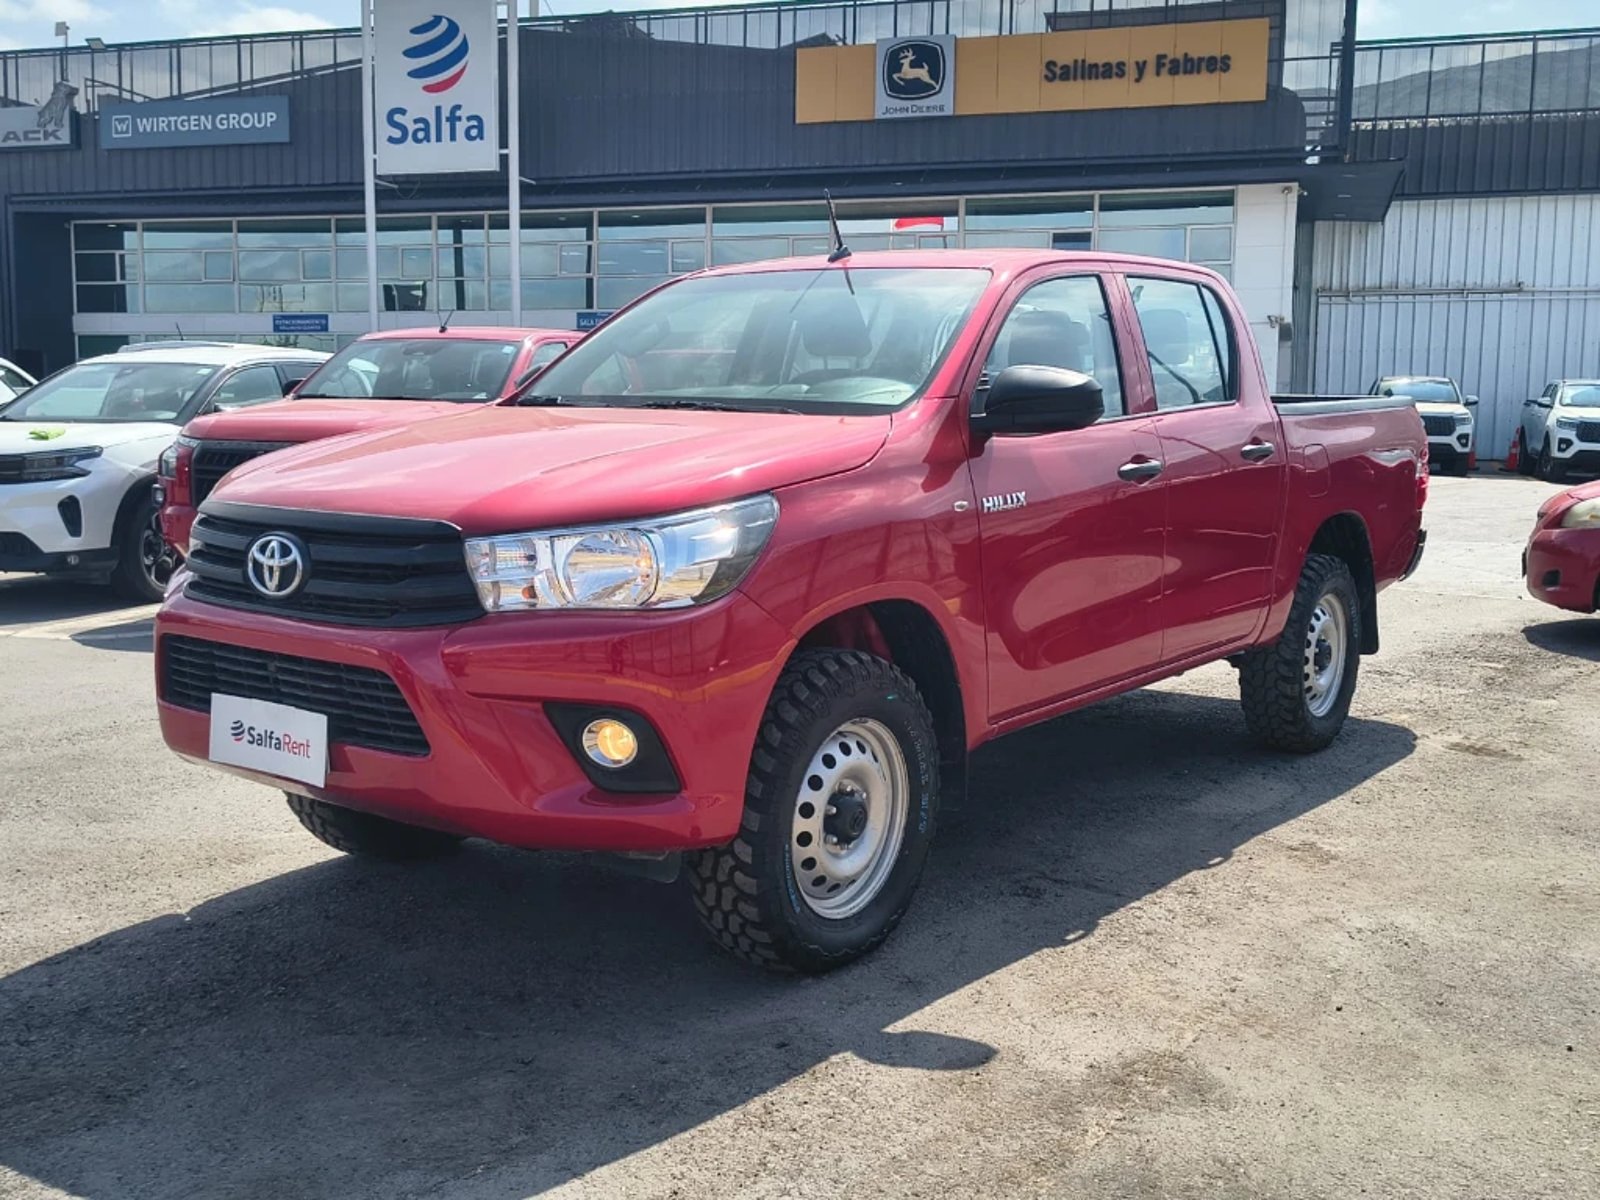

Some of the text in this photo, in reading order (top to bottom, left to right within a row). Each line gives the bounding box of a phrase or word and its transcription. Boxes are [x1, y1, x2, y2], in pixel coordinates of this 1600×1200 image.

[1043, 52, 1232, 83] Salinas y Fabres
[136, 114, 213, 133] WIRTGEN
[215, 111, 278, 130] GROUP
[386, 104, 485, 145] Salfa
[982, 491, 1027, 514] HILUX
[247, 725, 311, 759] SalfaRent
